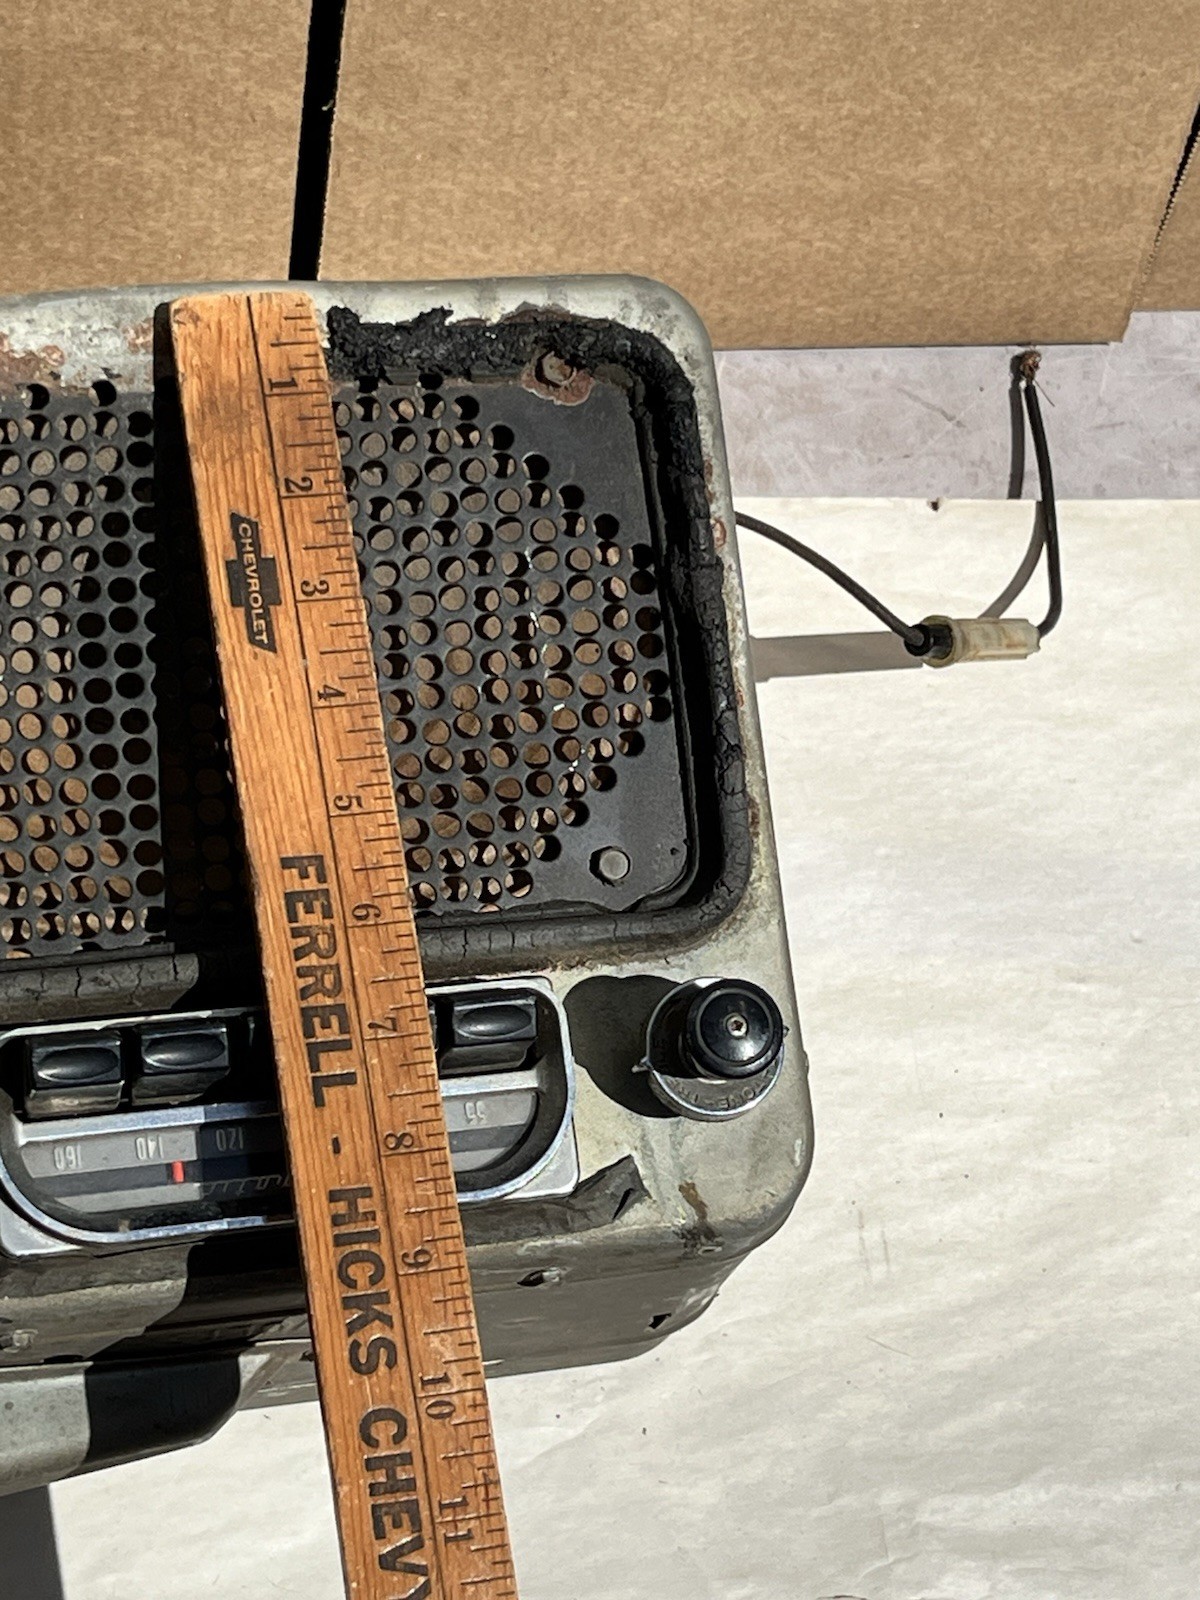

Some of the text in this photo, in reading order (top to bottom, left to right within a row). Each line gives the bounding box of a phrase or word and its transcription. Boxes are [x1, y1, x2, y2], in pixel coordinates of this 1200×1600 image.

[238, 523, 269, 645] CHEVROLET
[268, 377, 474, 1544] 1 2 3 4 5 6 7 8 9 10 11
[280, 854, 358, 1107] FERRELL
[329, 1185, 398, 1376] HICKS
[53, 1100, 487, 1170] 55 120 140 160
